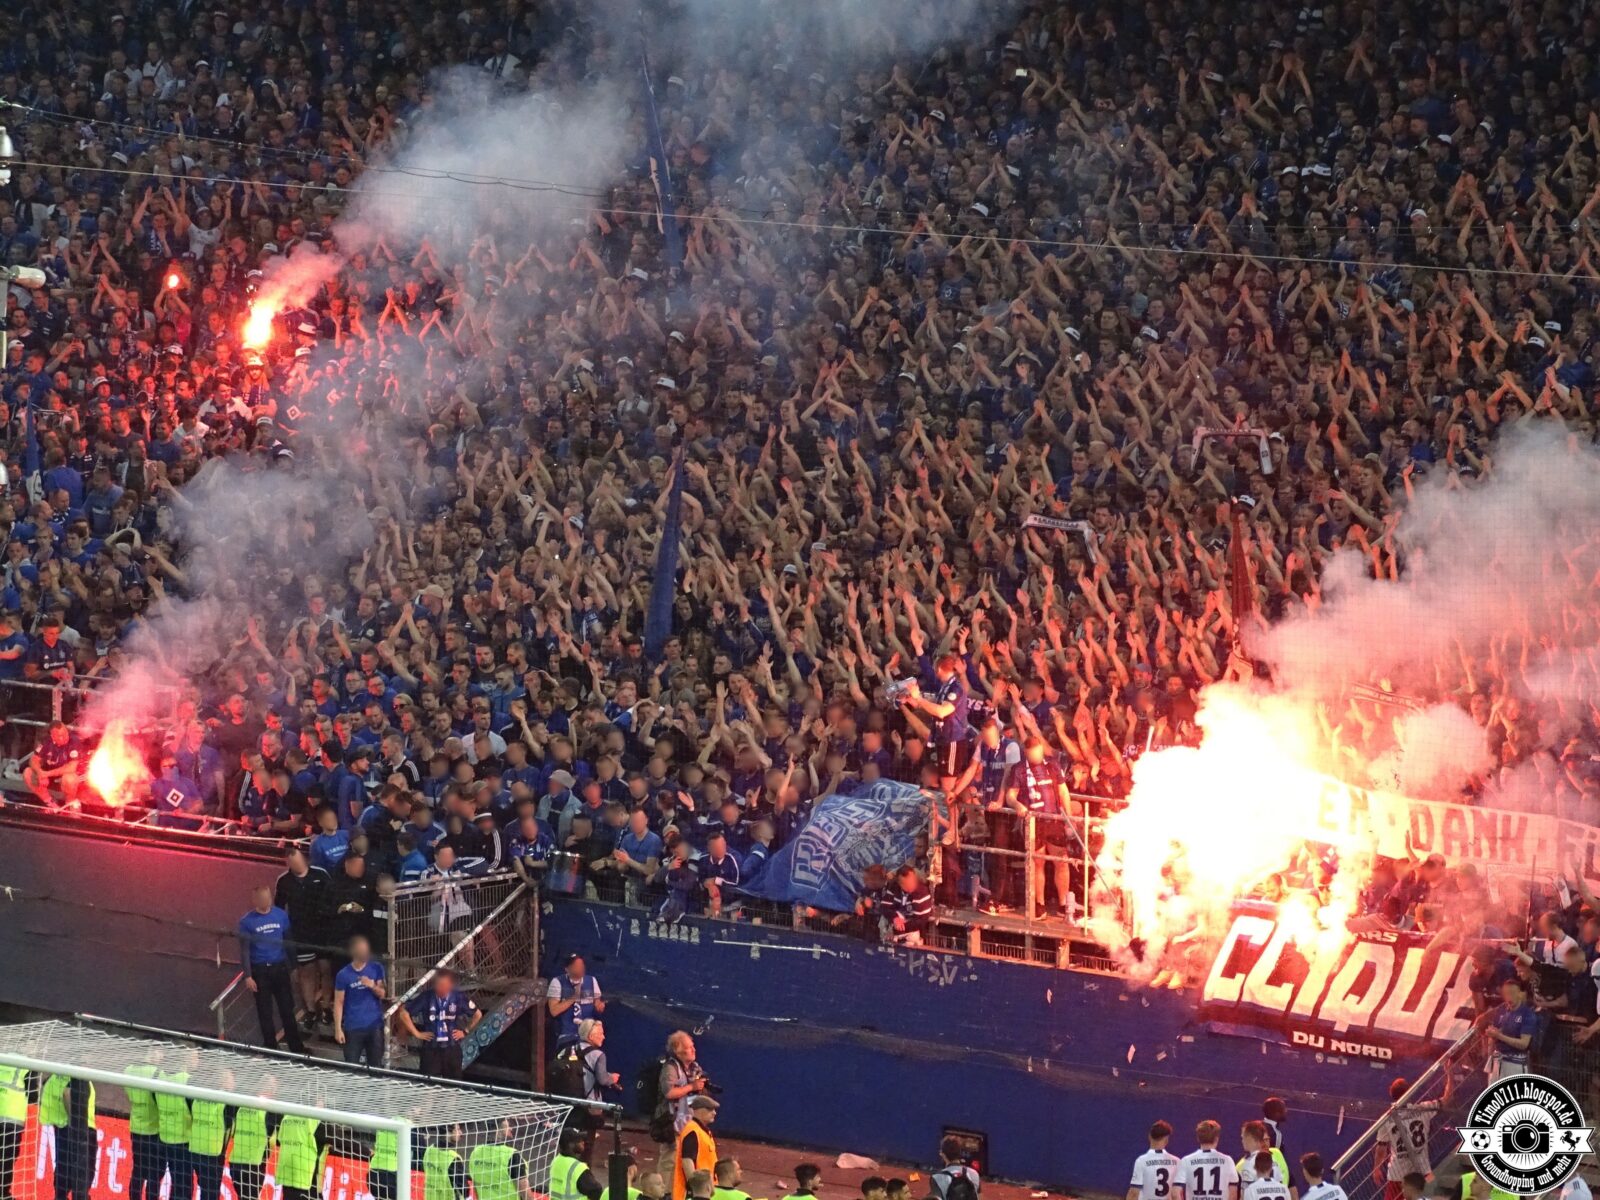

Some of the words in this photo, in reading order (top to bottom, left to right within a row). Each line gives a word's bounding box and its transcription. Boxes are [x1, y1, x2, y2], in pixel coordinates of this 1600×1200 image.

[1408, 801, 1529, 865] DANK
[1293, 1031, 1324, 1048] DU
[1331, 1039, 1392, 1059] NORD
[1154, 1168, 1170, 1197] 3
[1193, 1167, 1222, 1196] 11
